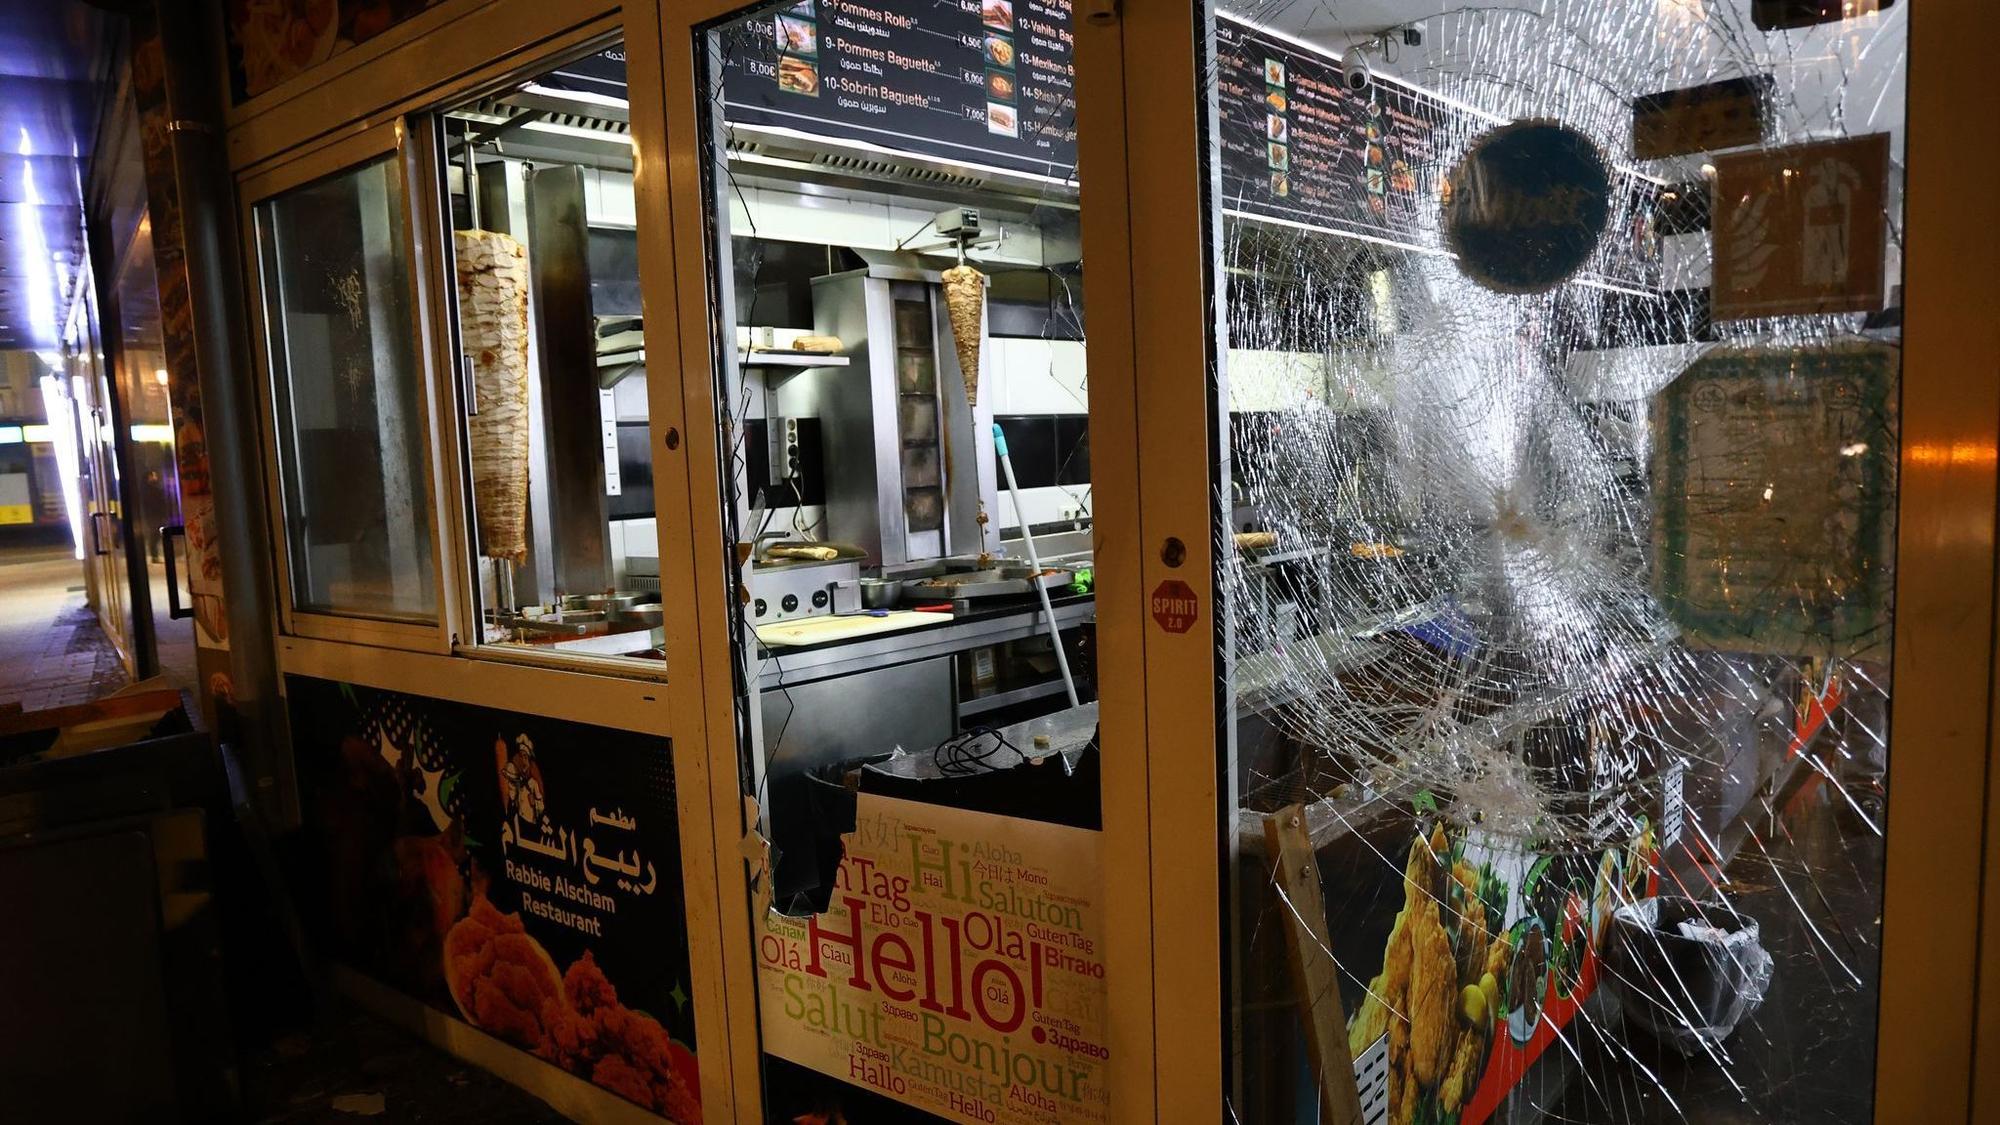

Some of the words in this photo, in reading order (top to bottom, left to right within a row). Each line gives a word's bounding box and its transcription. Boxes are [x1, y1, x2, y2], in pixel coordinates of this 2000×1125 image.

[884, 10, 912, 30] Rolle
[750, 62, 776, 76] 8,00€
[887, 50, 936, 74] Baguette
[880, 86, 929, 108] Baguette
[966, 108, 985, 121] 7,00€
[1153, 598, 1196, 616] SPIRIT
[1168, 617, 1182, 628] 2.0
[590, 806, 637, 831] مطعم
[501, 813, 578, 868] الشام
[972, 842, 1022, 866] Aloha
[583, 837, 657, 895] ربيع
[905, 834, 979, 904] Hi
[923, 871, 943, 888] Hai
[1017, 868, 1048, 886] Mono
[506, 859, 552, 893] Rabbie
[554, 876, 616, 914] Alscham
[851, 857, 911, 912] Tag
[523, 892, 602, 937] Restaurant
[870, 902, 900, 928] Elo
[979, 881, 1083, 931] Saluton
[964, 911, 1027, 961] Ola
[1026, 922, 1068, 946] Guten
[1069, 931, 1094, 956] Tag
[761, 935, 802, 972] Olá
[821, 943, 852, 966] Ciau
[805, 896, 1048, 1045] Hello!
[892, 971, 917, 988] Aloha
[986, 986, 1010, 1005] Olá
[784, 973, 887, 1049] Salut
[882, 1000, 919, 1022] Здраво
[1032, 1011, 1063, 1029] Guten
[855, 1041, 890, 1062] Здраво
[920, 1012, 1088, 1103] Bonjour
[1048, 1028, 1110, 1060] Здраво
[848, 1053, 905, 1095] Hallo
[890, 1043, 1004, 1106] Kamusta
[949, 1091, 995, 1124] Hello
[1009, 1084, 1057, 1113] Aloha
